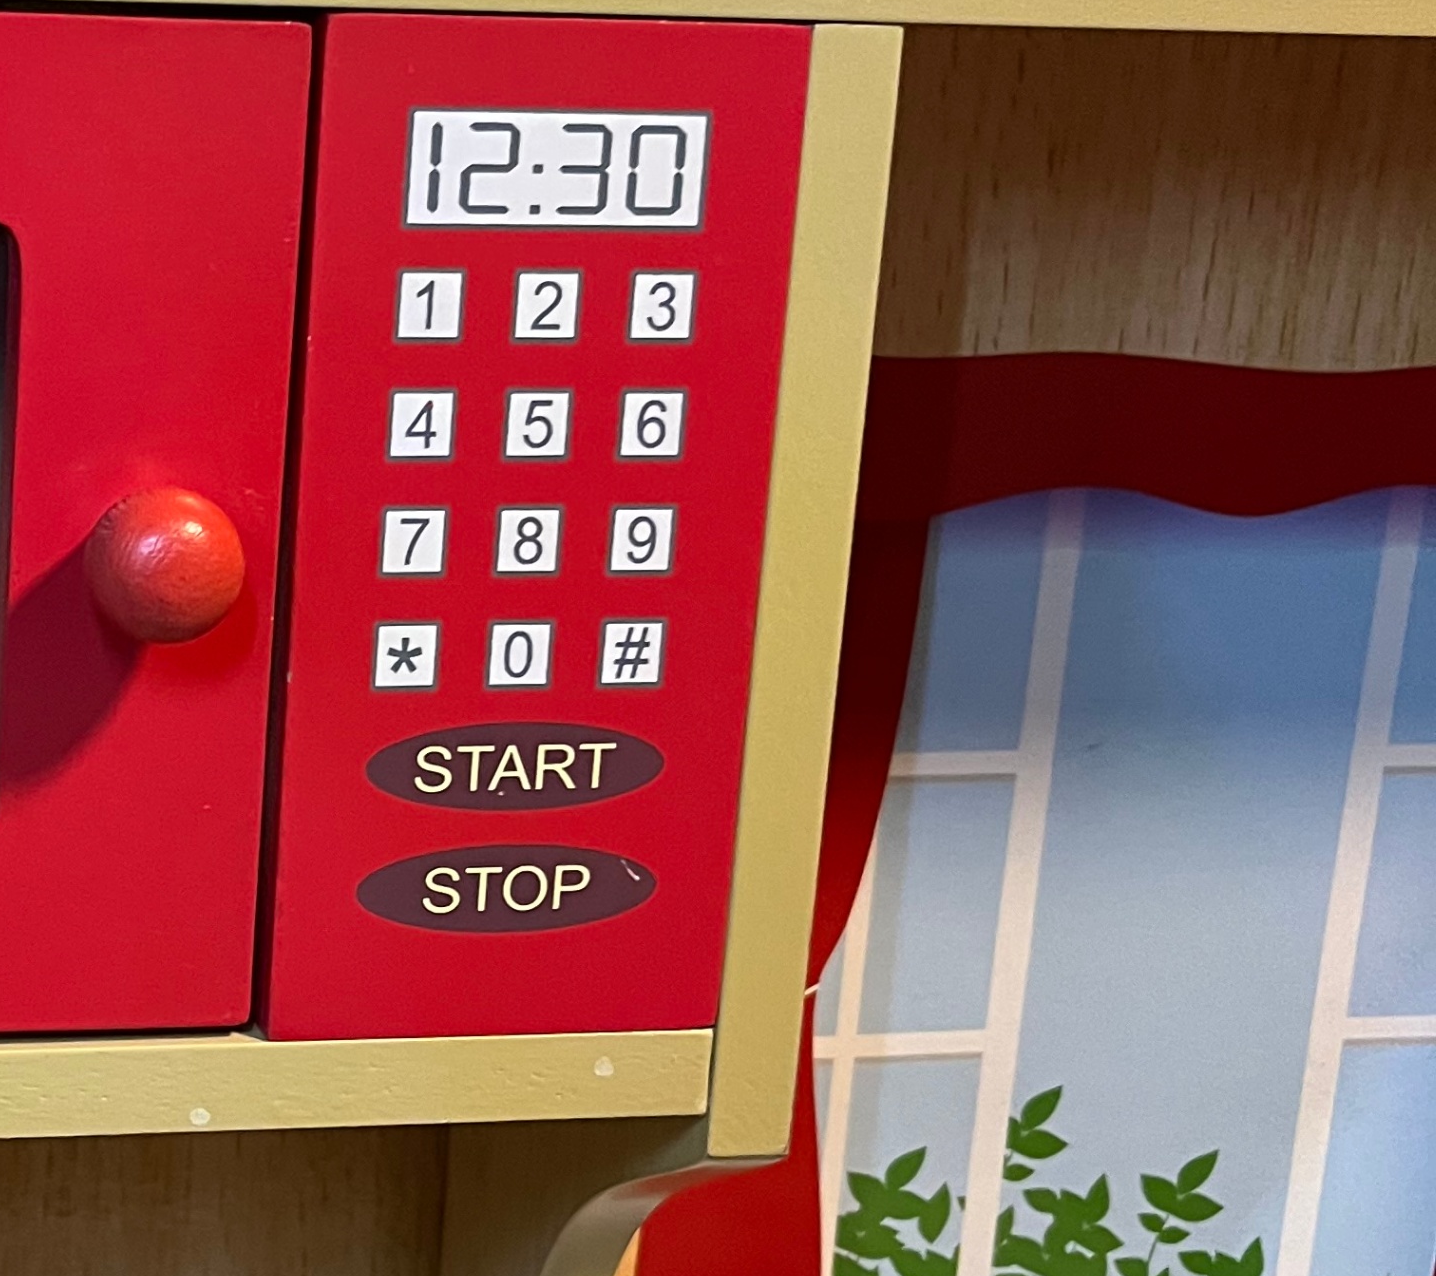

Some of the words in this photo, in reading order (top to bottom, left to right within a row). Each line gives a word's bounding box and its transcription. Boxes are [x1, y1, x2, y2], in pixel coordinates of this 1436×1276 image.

[427, 122, 687, 216] 12:30
[415, 279, 436, 330] 1
[531, 280, 563, 330] 2
[646, 281, 676, 332] 3
[405, 400, 437, 449] 4
[523, 400, 554, 449] 5
[637, 400, 667, 449] 6
[400, 518, 430, 566] 7
[514, 516, 543, 565] 8
[627, 516, 656, 564] 9
[504, 630, 533, 678] 0
[613, 626, 651, 679] #
[414, 742, 617, 793] START
[422, 864, 592, 914] STOP
